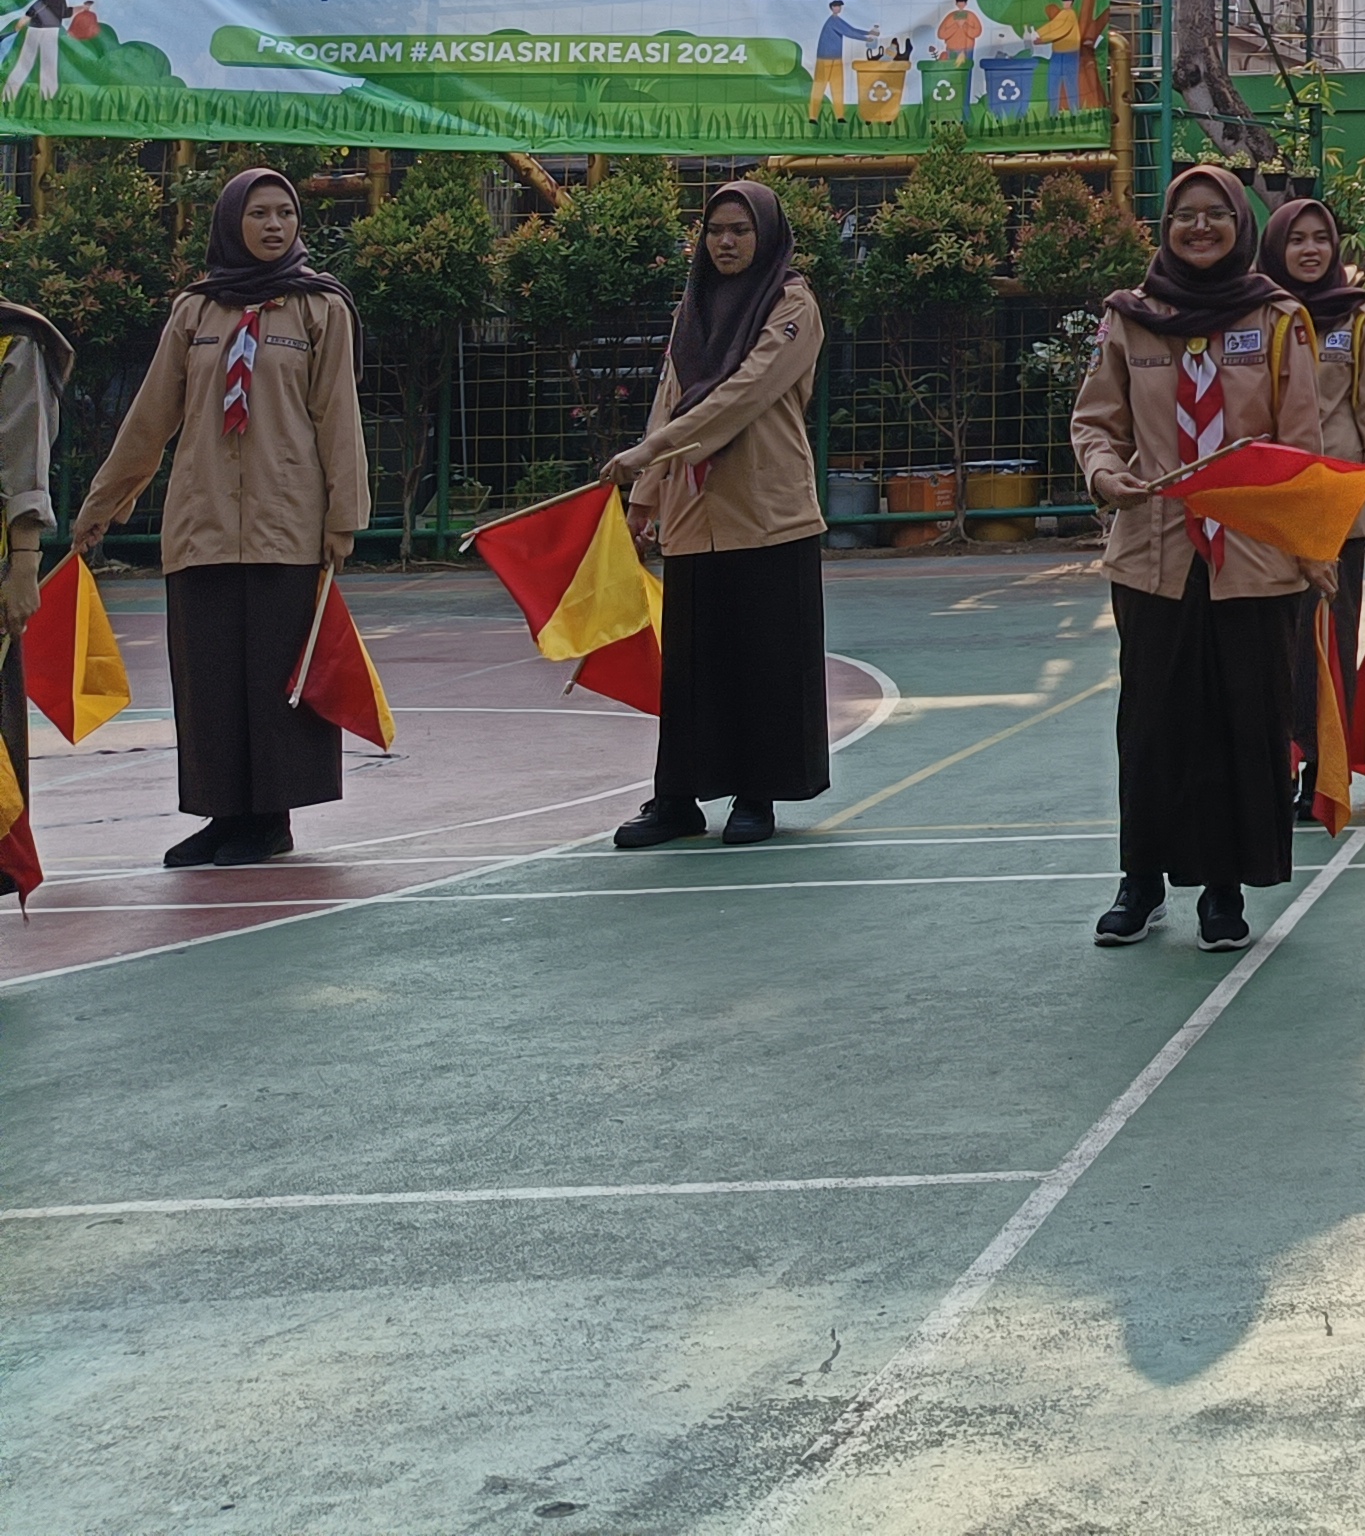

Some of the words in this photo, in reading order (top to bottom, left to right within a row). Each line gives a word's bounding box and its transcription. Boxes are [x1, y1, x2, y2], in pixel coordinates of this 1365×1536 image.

[257, 35, 403, 63] PROGRAM
[409, 40, 560, 63] #AKSIASRI
[568, 41, 670, 64] KREASI
[677, 42, 748, 65] 2024
